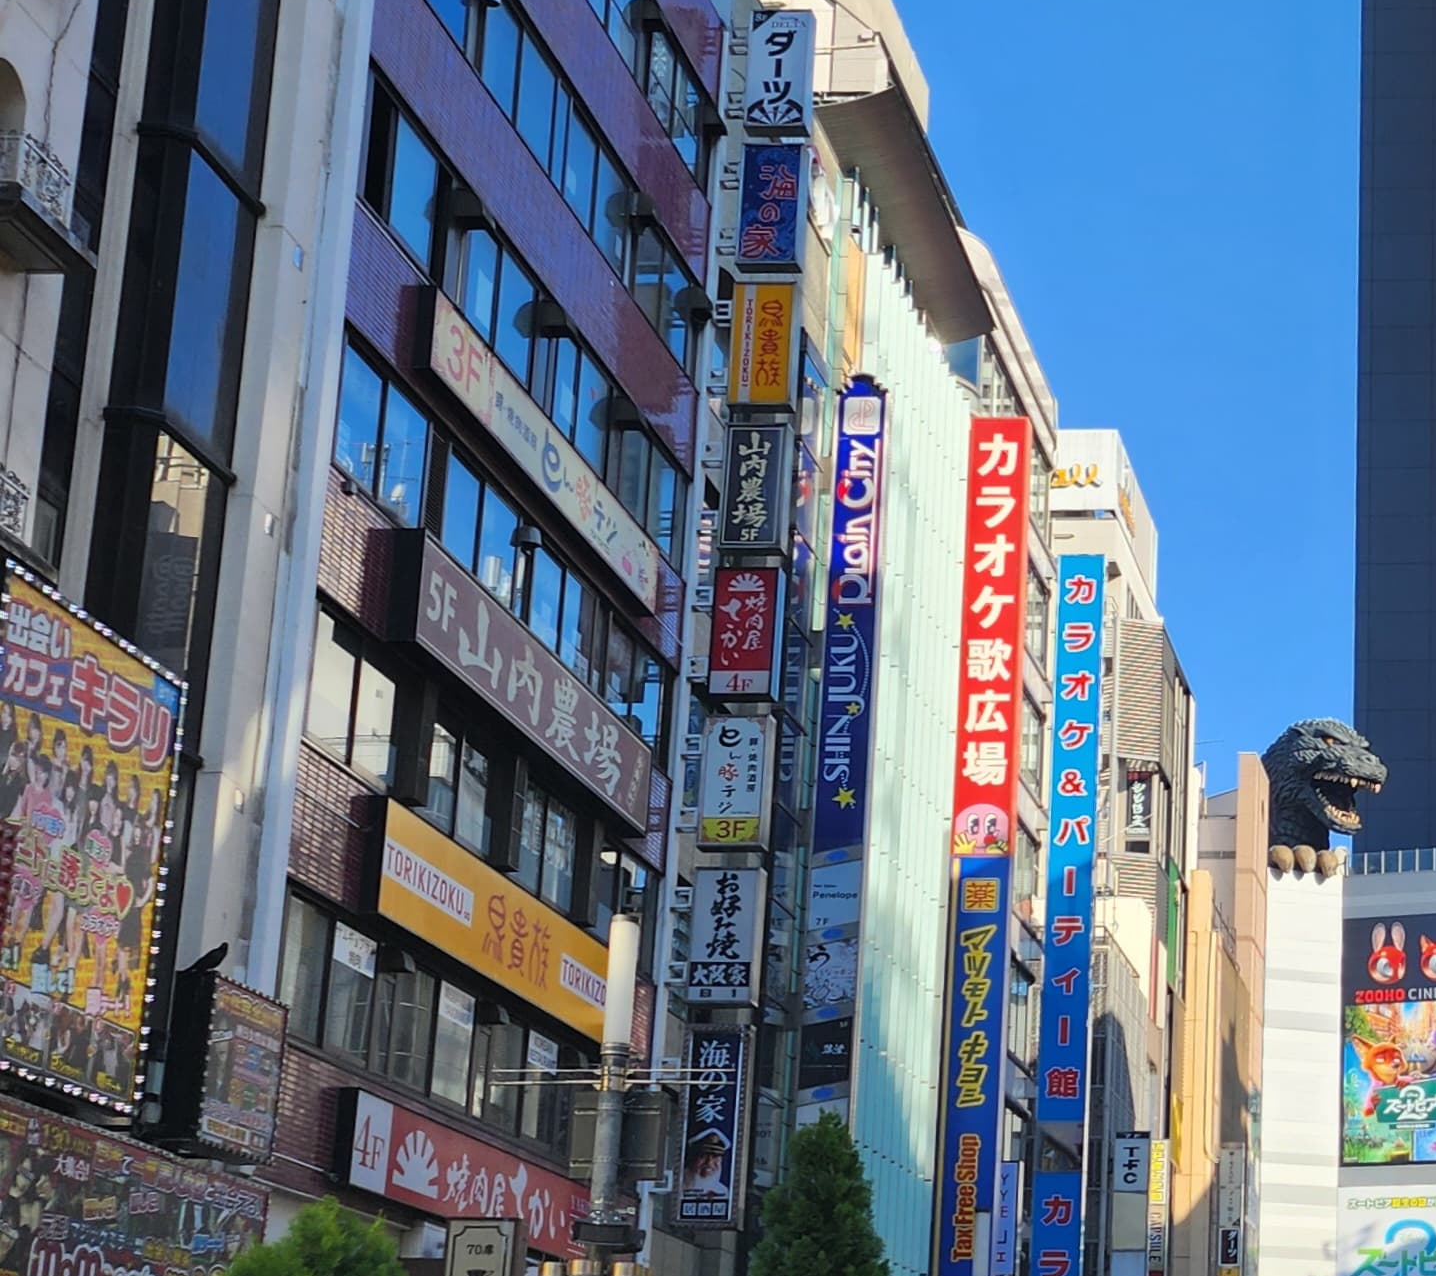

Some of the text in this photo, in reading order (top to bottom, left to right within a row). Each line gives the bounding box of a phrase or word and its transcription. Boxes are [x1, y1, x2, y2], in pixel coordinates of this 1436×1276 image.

[765, 29, 797, 105] ダーツ
[741, 165, 798, 259] 海の家
[447, 323, 485, 393] 3F
[731, 431, 771, 529] 山内農場
[740, 528, 760, 542] 5F
[6, 601, 71, 660] 出会い
[427, 570, 458, 633] 5F
[742, 591, 768, 652] 焼肉屋
[963, 433, 1021, 785] カラオケ歌広場
[4, 651, 172, 770] カフェ キラリ
[458, 600, 623, 798] 山内農場
[725, 673, 754, 693] 4F
[716, 820, 747, 839] 3F
[1045, 575, 1097, 1100] カラオケ&パーティー館
[386, 844, 466, 921] TORIKIZOKU
[561, 957, 607, 1005] TORIKIZO
[706, 872, 744, 961] お好み焼
[965, 880, 997, 910] 薬
[956, 923, 998, 1107] マツモトキヨシ
[1355, 987, 1406, 1004] ZOOHO
[695, 1040, 733, 1124] 海の家
[353, 1114, 386, 1171] 4F
[952, 1135, 979, 1262] Tax Free Shop
